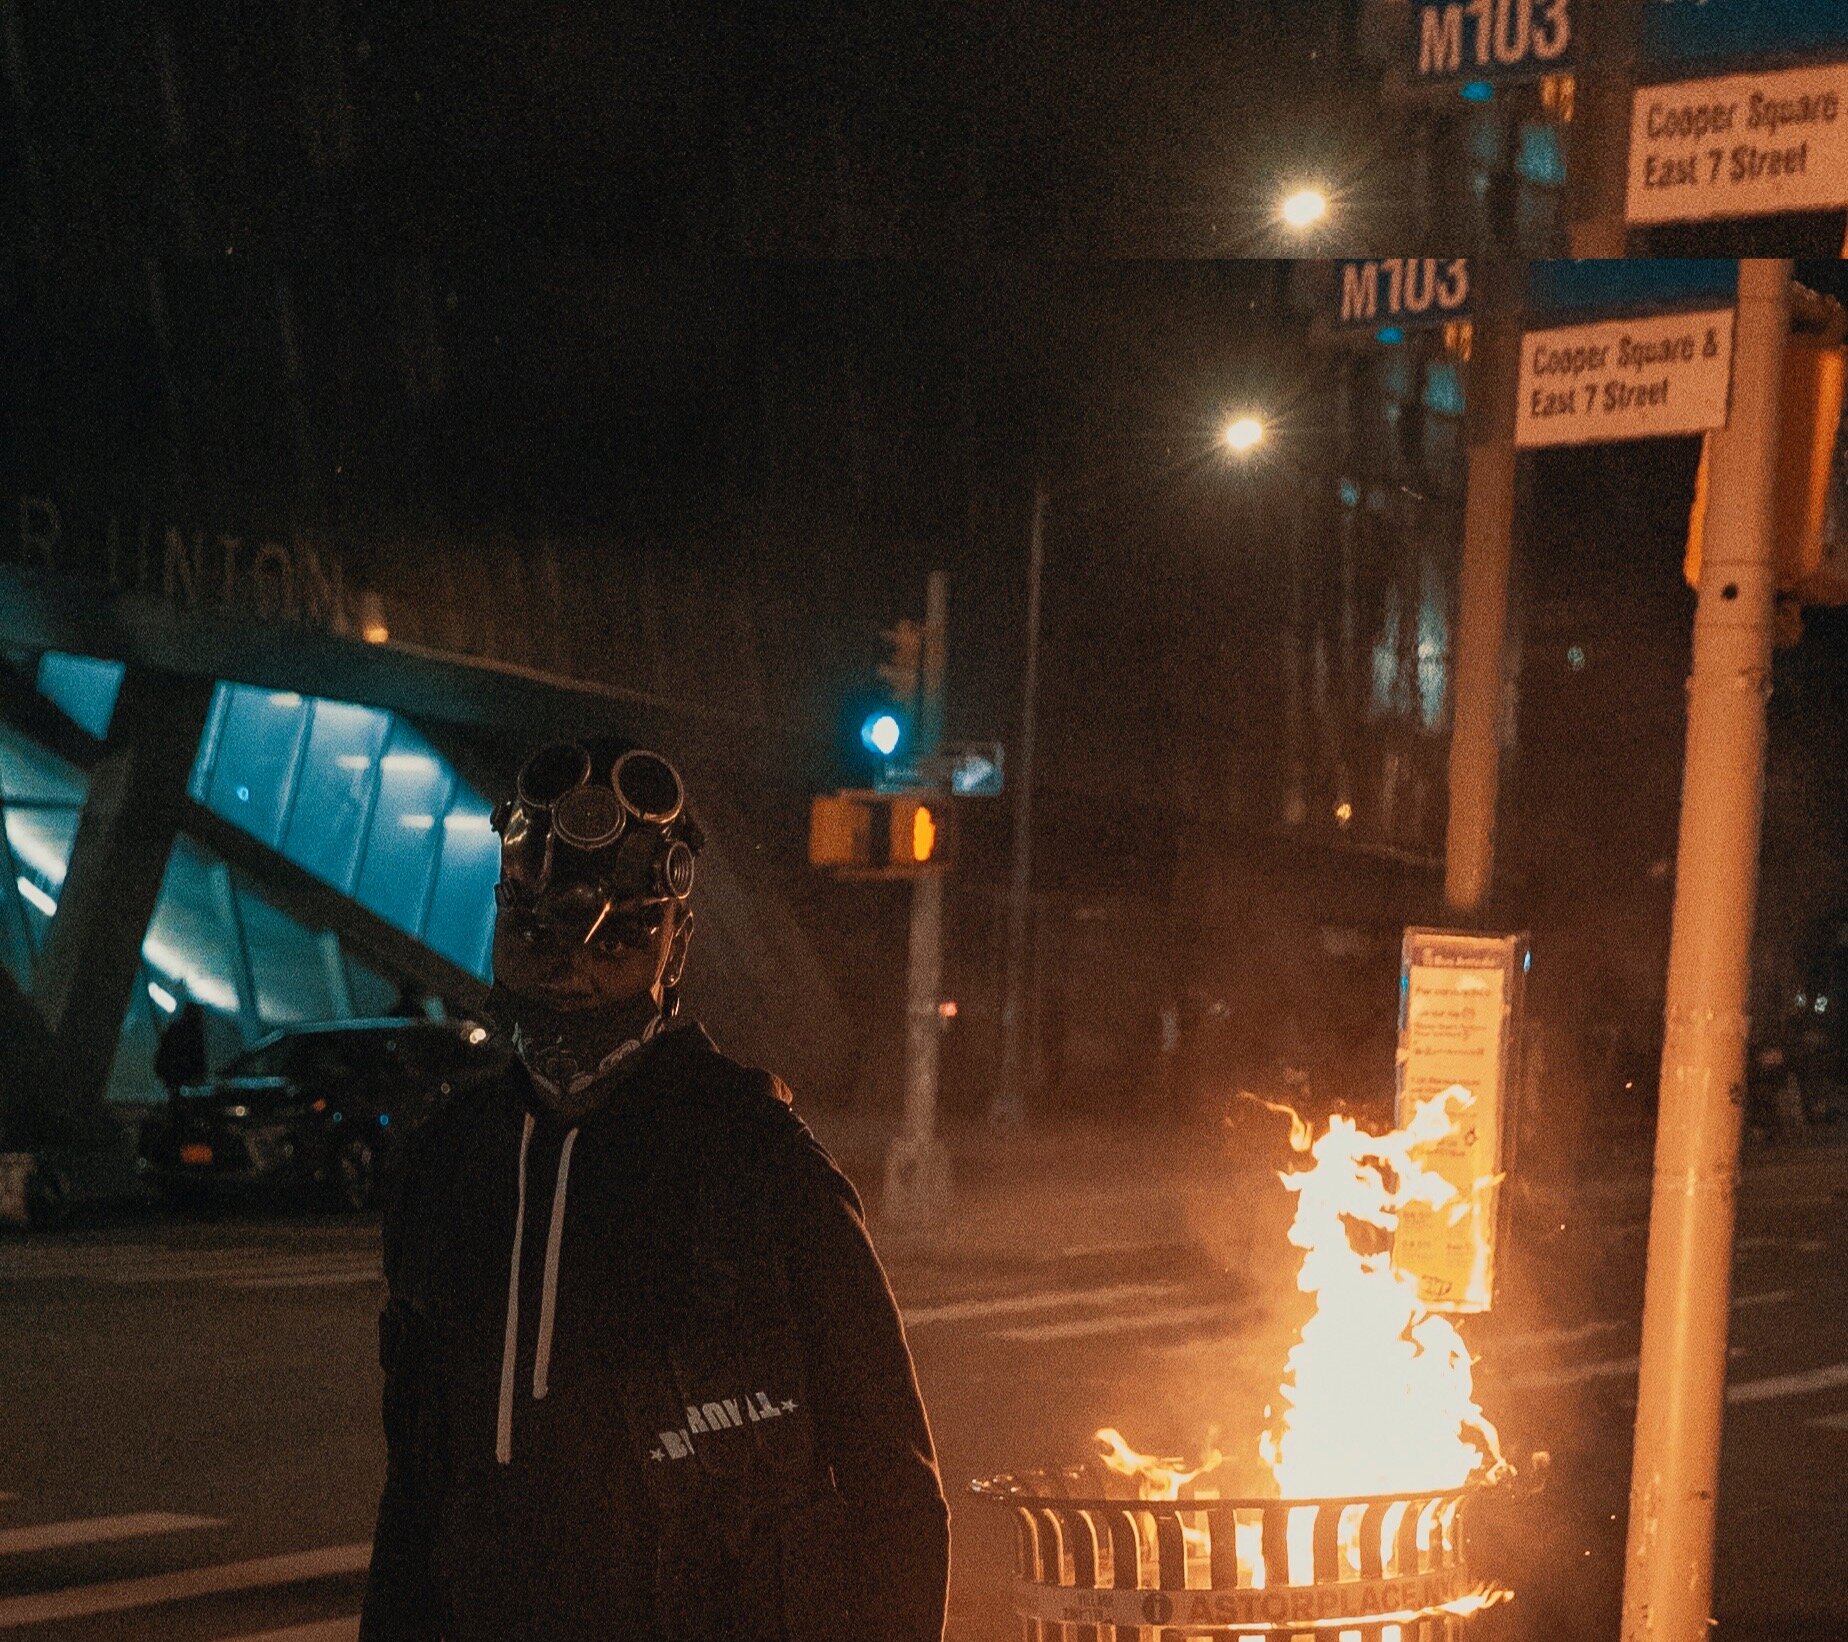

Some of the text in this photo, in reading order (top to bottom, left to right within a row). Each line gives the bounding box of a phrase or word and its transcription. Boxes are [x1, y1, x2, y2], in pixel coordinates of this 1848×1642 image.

[1418, 0, 1571, 74] M103
[1647, 91, 1839, 139] Cooper Square
[1645, 141, 1807, 188] East 7 Street
[1340, 258, 1469, 322] M103
[1533, 345, 1609, 379] Cooper
[1616, 335, 1695, 373] Square
[1531, 376, 1669, 417] East 7 Street
[106, 510, 351, 636] UNION
